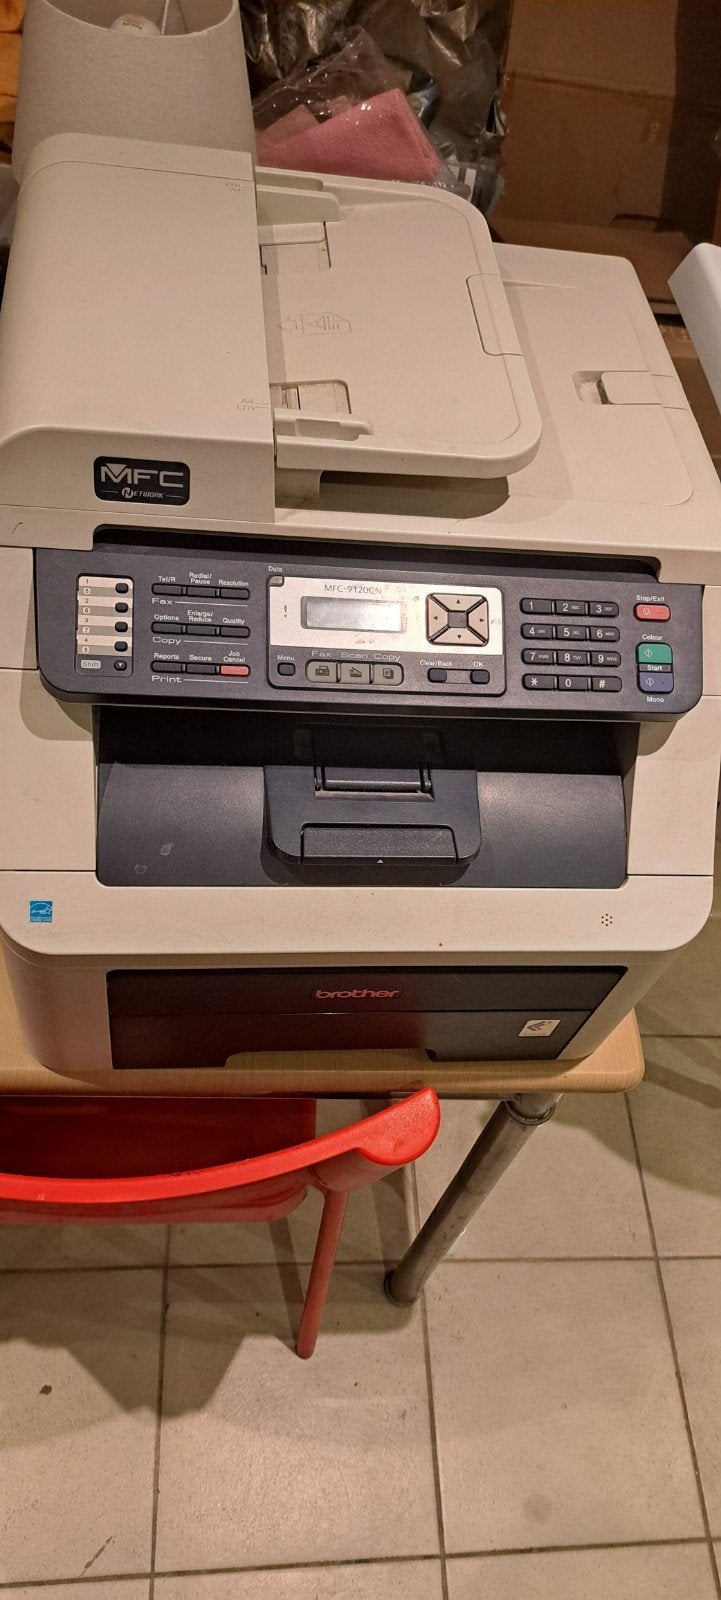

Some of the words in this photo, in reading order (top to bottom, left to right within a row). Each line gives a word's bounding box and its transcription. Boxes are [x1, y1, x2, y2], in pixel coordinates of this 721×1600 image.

[100, 463, 184, 488] MFC
[122, 487, 164, 498] NETWORK
[324, 584, 382, 594] MFC-9120CN
[529, 602, 533, 611] 1
[562, 603, 568, 612] 2
[596, 604, 602, 613] 3
[154, 614, 179, 622] Options
[529, 627, 535, 635] 4
[564, 628, 570, 636] 5
[597, 630, 602, 638] 6
[152, 637, 182, 645] Copy
[312, 650, 332, 658] Fax
[340, 651, 368, 659] Scan
[373, 653, 401, 662] Copy
[530, 652, 536, 661] 7
[564, 653, 570, 662] 8
[598, 654, 604, 663] 9
[420, 659, 453, 667] Clear/Back
[566, 678, 571, 687] 0
[599, 680, 606, 688] #
[316, 990, 399, 998] brother
